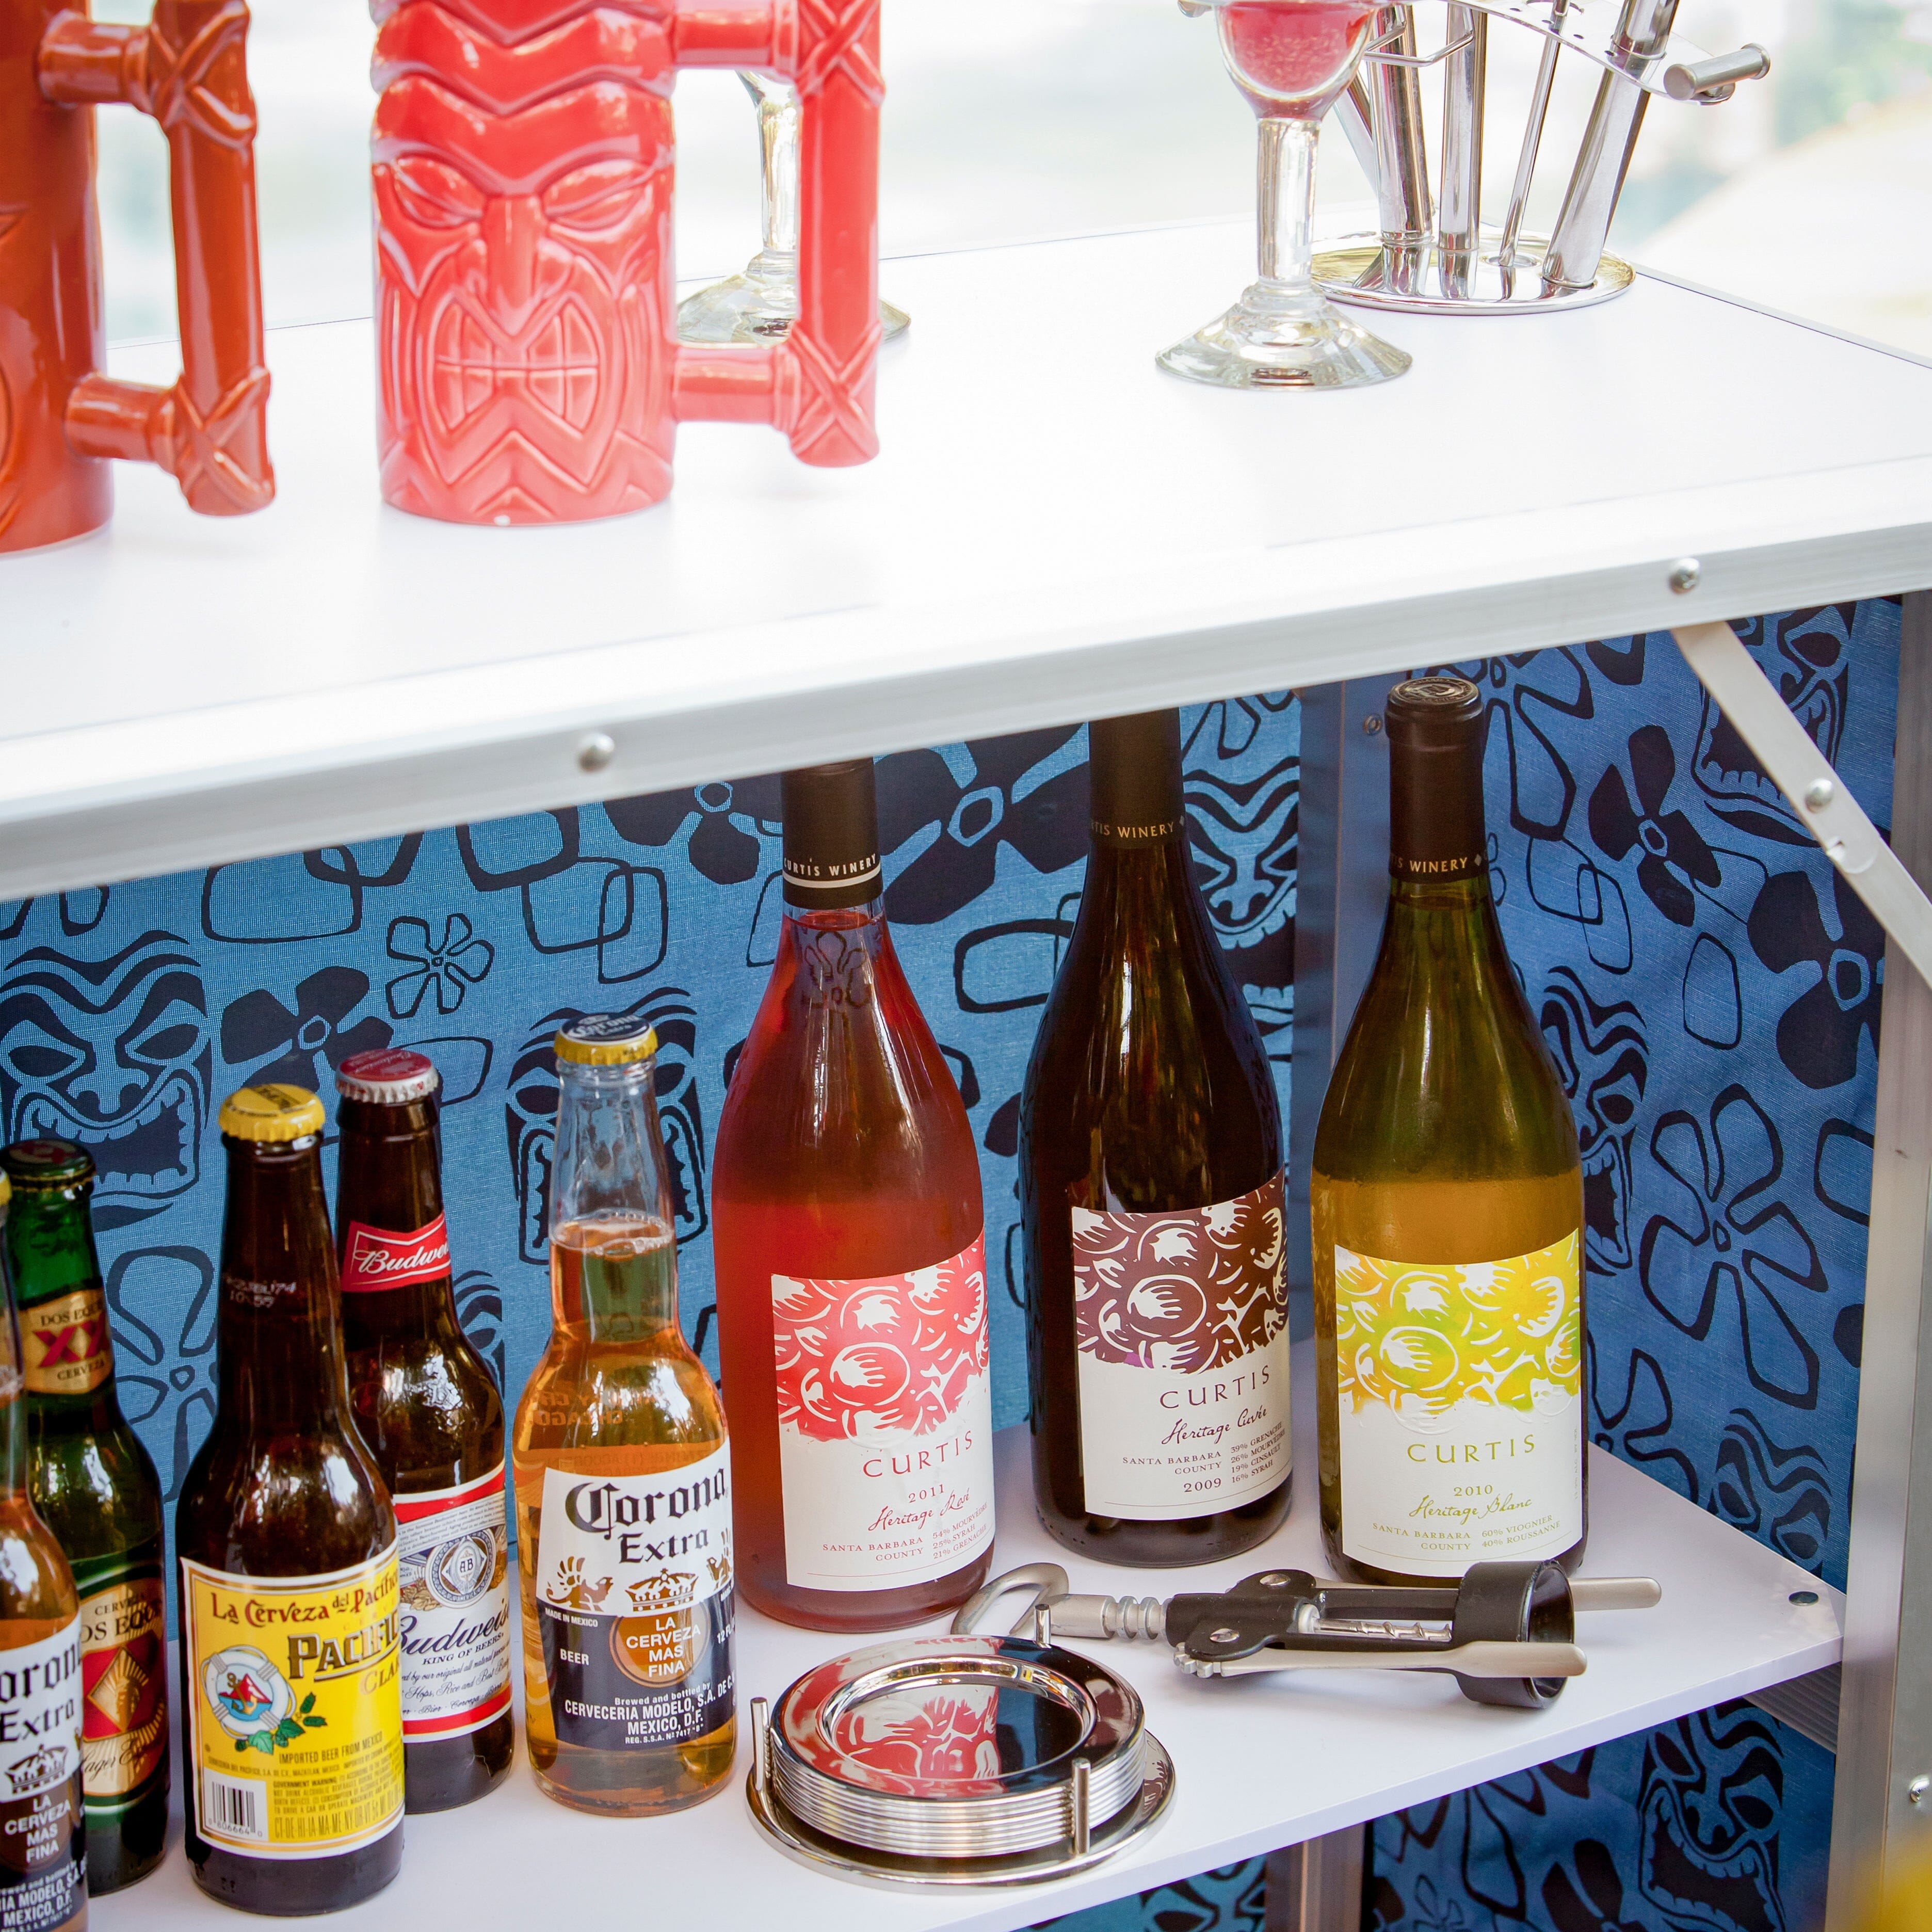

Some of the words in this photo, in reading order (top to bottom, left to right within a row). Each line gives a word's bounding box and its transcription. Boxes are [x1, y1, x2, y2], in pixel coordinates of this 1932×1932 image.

[1118, 822, 1174, 838] WINERY
[784, 857, 820, 876] CURTIS
[829, 853, 876, 876] WINERY
[1410, 857, 1468, 873] WINERY
[41, 1311, 70, 1326] DOS
[1160, 1364, 1270, 1409] CURTIS
[1161, 1419, 1231, 1445] Heritage
[1237, 1405, 1267, 1427] Cuvée
[1230, 1443, 1248, 1454] 39%
[1250, 1421, 1283, 1446] GRENACHE
[1407, 1434, 1535, 1463] CURTIS
[863, 1430, 973, 1477] CURTIS
[1123, 1457, 1162, 1465] SANTA
[1168, 1451, 1221, 1464] BARBARA
[1231, 1453, 1248, 1463] 26%
[1231, 1463, 1248, 1474] 19%
[1251, 1443, 1281, 1466] CINSAULT
[1175, 1461, 1222, 1475] COUNTY
[1232, 1473, 1248, 1484] 16%
[1251, 1459, 1273, 1476] SYRAH
[908, 1484, 944, 1503] 2011
[1183, 1477, 1221, 1493] 2009
[1454, 1484, 1493, 1496] 2010
[566, 1469, 725, 1540] Corona
[868, 1505, 933, 1532] Heritage
[940, 1487, 970, 1517] Rosé
[1409, 1494, 1478, 1525] Heritage
[1478, 1492, 1532, 1519] Blanc
[932, 1528, 951, 1539] 54%
[932, 1538, 951, 1549] 25%
[952, 1523, 976, 1542] SYRAH
[1373, 1522, 1409, 1537] SANTA
[1414, 1531, 1471, 1539] BARBARA
[1482, 1528, 1503, 1537] 60%
[1506, 1514, 1553, 1535] VIOGNIER
[1482, 1538, 1503, 1548] 40%
[1507, 1520, 1561, 1544] ROUSSANNE
[618, 1530, 708, 1564] Extra
[822, 1543, 863, 1552] SANTA
[868, 1537, 924, 1551] BARBARA
[932, 1549, 951, 1559] 21%
[953, 1523, 988, 1552] GRENACHE
[1421, 1542, 1471, 1550] COUNTY
[460, 1558, 474, 1572] AB
[876, 1548, 924, 1561] COUNTY
[211, 1592, 239, 1624] La
[245, 1600, 330, 1628] Cerveza
[332, 1593, 349, 1614] del
[545, 1607, 561, 1620] MADE
[563, 1615, 570, 1623] IN
[571, 1616, 598, 1627] MEXICO
[656, 1616, 675, 1631] LA
[626, 1624, 701, 1649] CERVEZA
[717, 1630, 725, 1644] 12
[422, 1654, 454, 1665] KING
[458, 1648, 473, 1659] OF
[560, 1648, 589, 1665] BEER
[649, 1645, 684, 1662] MAS
[411, 1670, 420, 1685] by
[436, 1662, 464, 1681] original
[463, 1659, 473, 1672] all
[474, 1653, 493, 1667] natural
[649, 1660, 685, 1677] FINA
[405, 1686, 434, 1702] Hops,
[436, 1681, 459, 1696] Rice
[461, 1676, 476, 1687] and
[476, 1666, 494, 1685] Best
[615, 1697, 650, 1706] Brewed
[652, 1694, 668, 1703] and
[671, 1685, 701, 1701] bottled
[702, 1682, 711, 1691] by
[418, 1704, 442, 1714] Bier
[450, 1695, 479, 1710] Cerveza
[565, 1699, 639, 1720] CERVECERIA
[642, 1698, 695, 1719] MODELO,
[697, 1689, 716, 1707] S.A.
[718, 1680, 727, 1697] DE
[0, 1698, 74, 1743] Extra
[627, 1716, 681, 1735] MEXICO,
[684, 1709, 703, 1726] D.F.
[279, 1751, 318, 1764] IMPORTED
[321, 1747, 339, 1761] BEER
[342, 1742, 360, 1758] FROM
[362, 1731, 382, 1750] MEXICO
[643, 1734, 665, 1743] S.S.A.
[676, 1729, 691, 1738] 7417
[33, 1795, 52, 1813] LA
[5, 1799, 71, 1835] CERVEZA
[217, 1820, 250, 1835] 806664
[27, 1823, 58, 1847] MAS
[27, 1840, 59, 1863] FINA
[19, 1878, 65, 1909] MODELO,
[4, 1900, 55, 1928] MEXICO,
